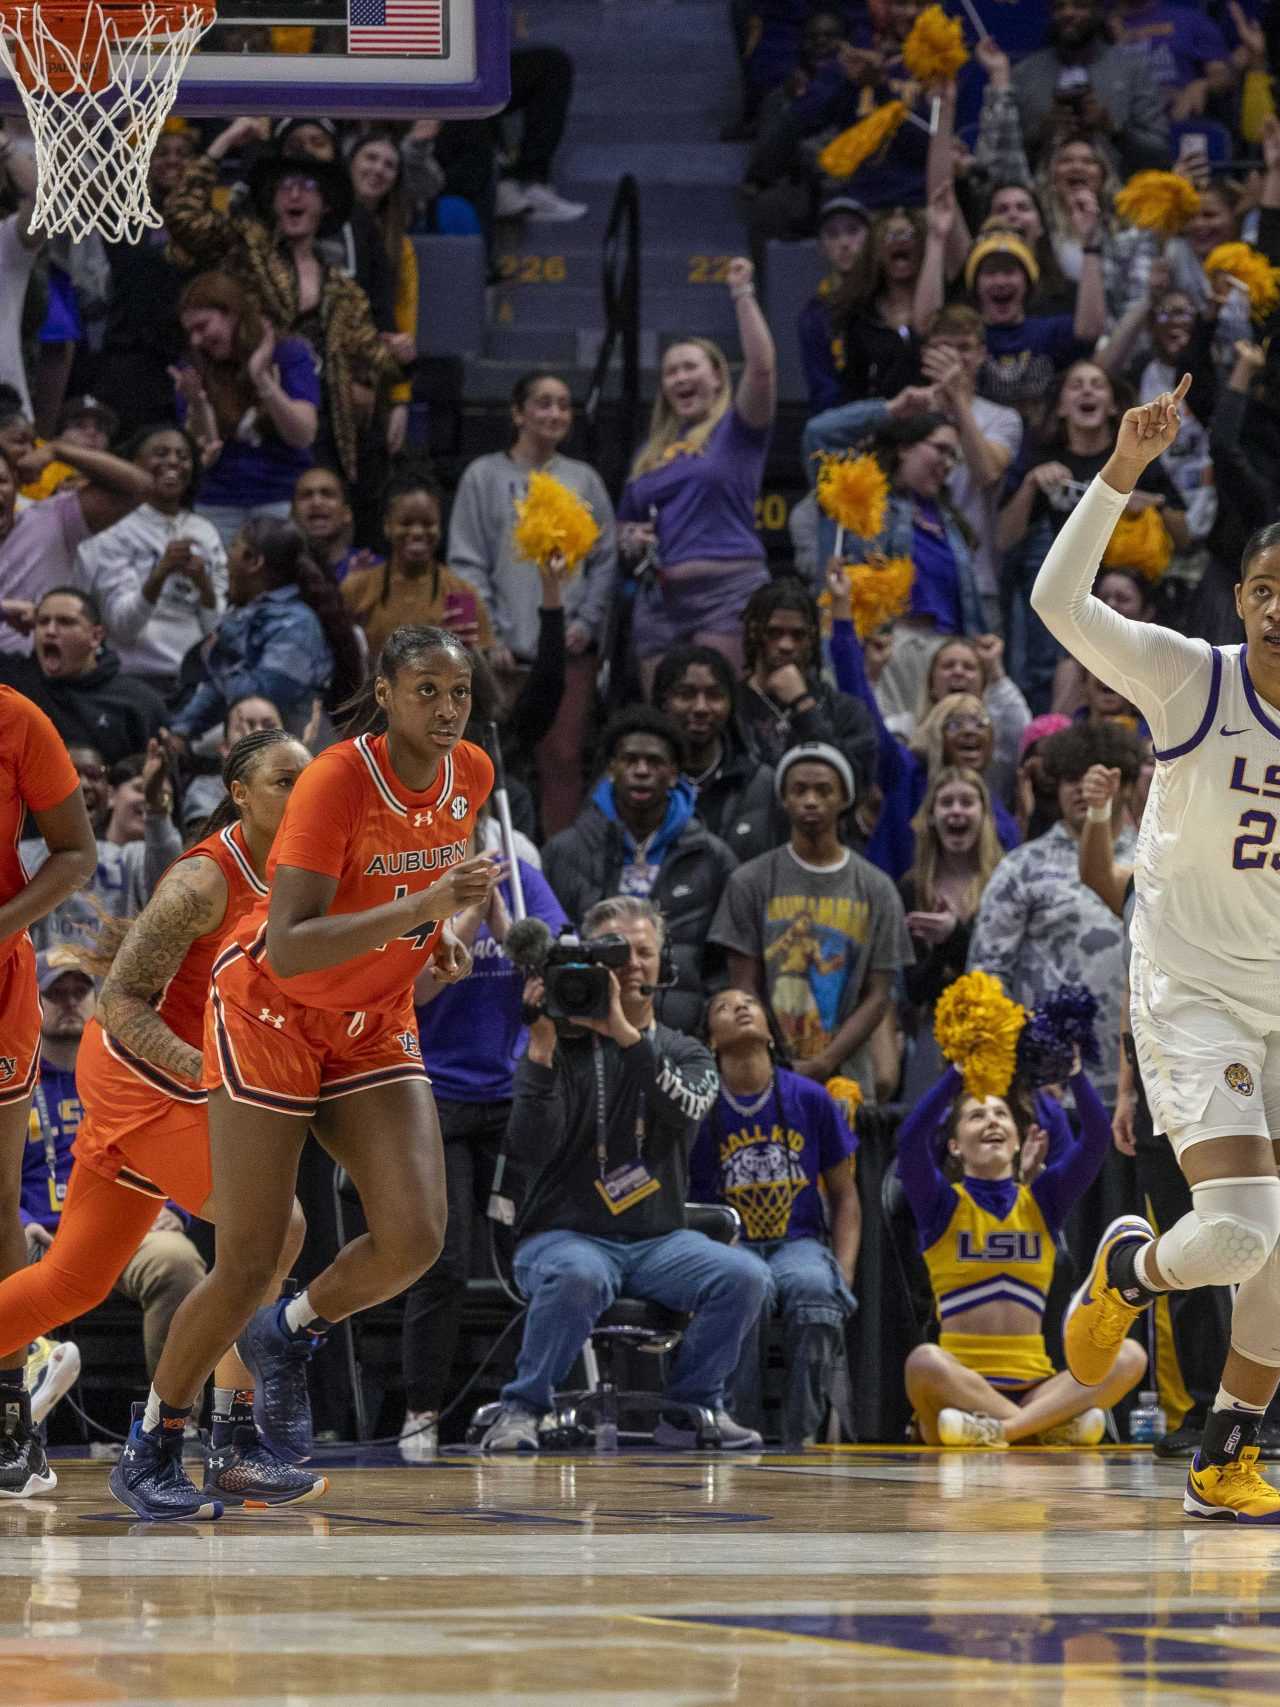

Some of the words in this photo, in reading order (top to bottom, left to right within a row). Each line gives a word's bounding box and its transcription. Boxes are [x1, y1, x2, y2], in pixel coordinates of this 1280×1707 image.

[688, 255, 736, 284] 22
[451, 796, 468, 820] SEC
[363, 838, 467, 876] AUBURN
[29, 1099, 84, 1143] LS
[957, 1231, 1042, 1264] LSU
